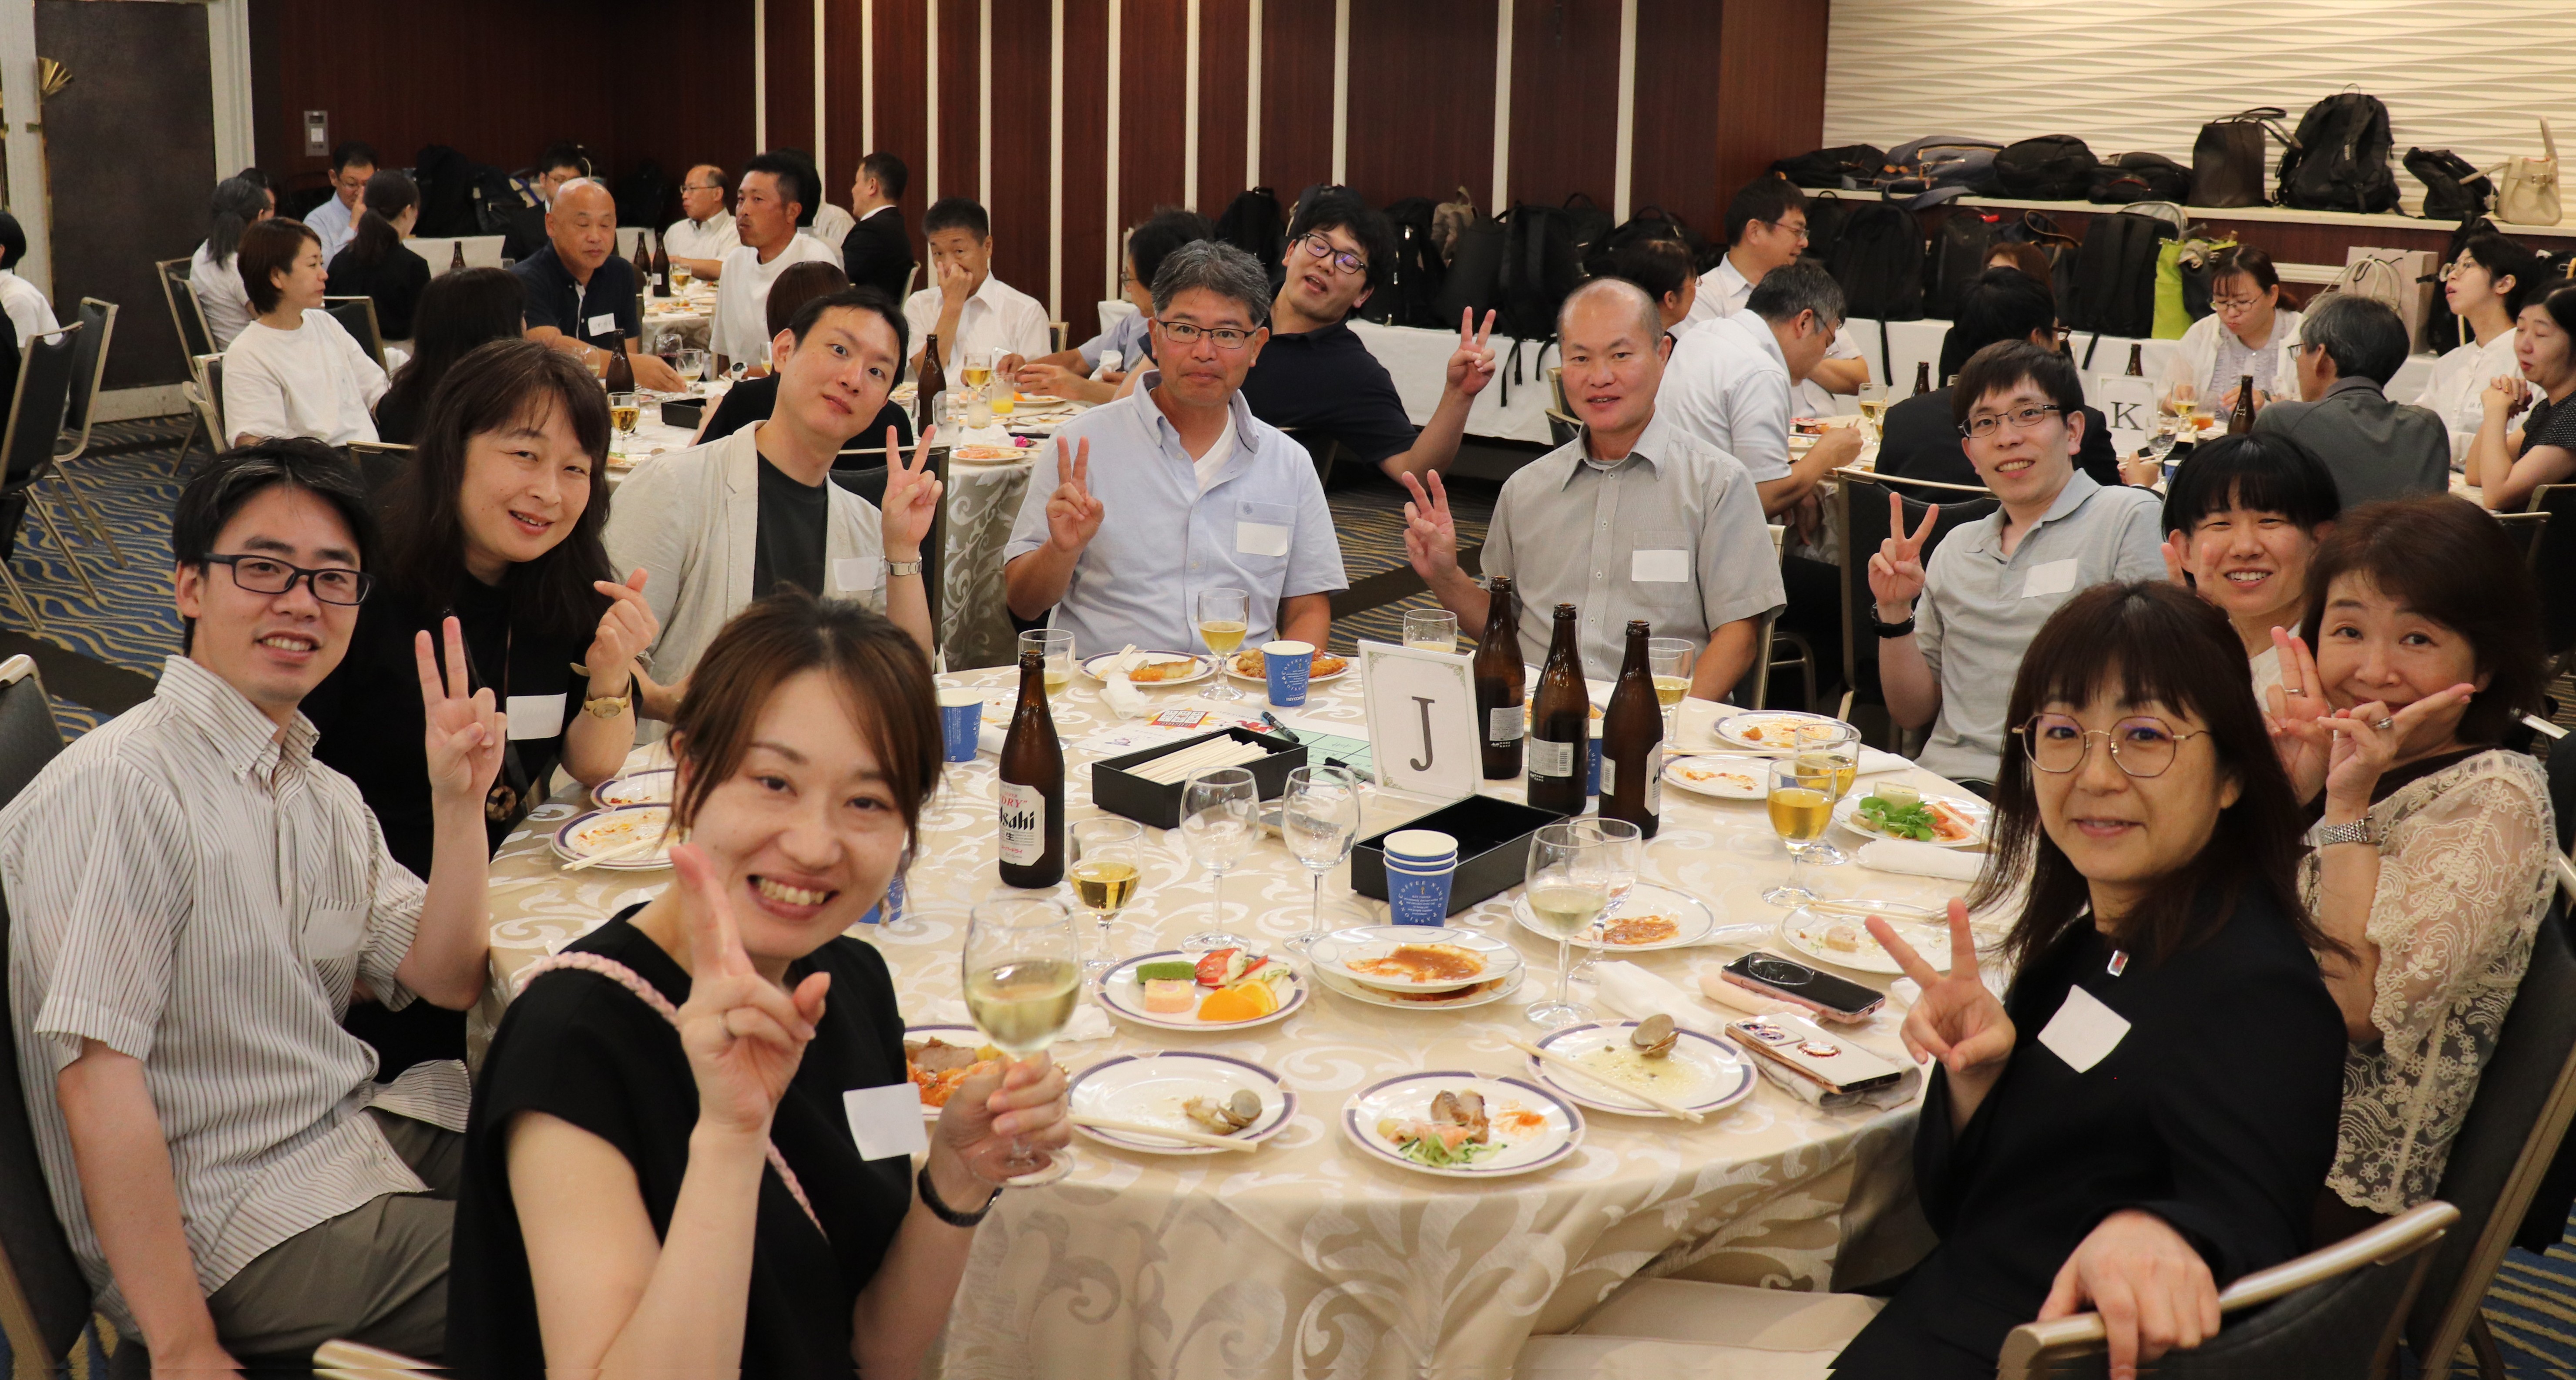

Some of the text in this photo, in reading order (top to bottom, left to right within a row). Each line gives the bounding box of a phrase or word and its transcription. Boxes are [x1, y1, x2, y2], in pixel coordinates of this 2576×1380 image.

[2111, 401, 2143, 430] K
[1410, 696, 1435, 771] J
[1005, 832, 1014, 841] 生
[1398, 880, 1426, 899] COFFEE
[1401, 907, 1437, 923] PASSION
